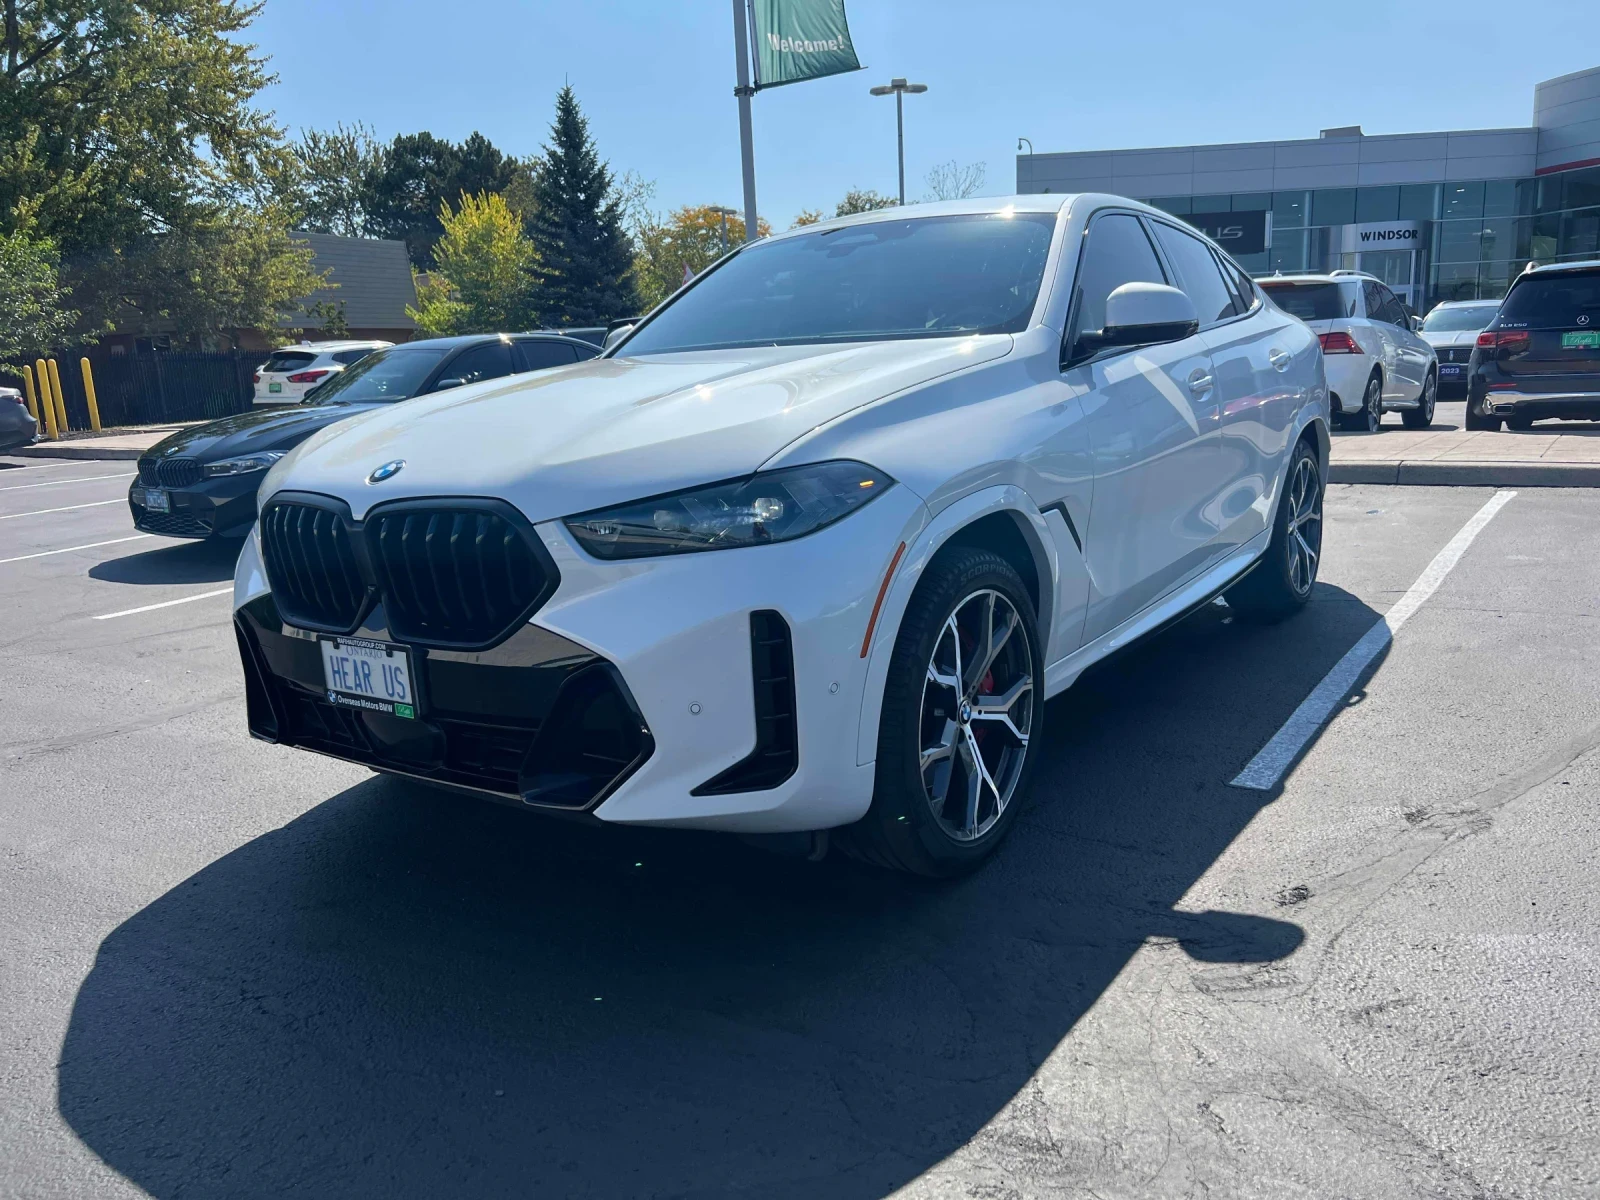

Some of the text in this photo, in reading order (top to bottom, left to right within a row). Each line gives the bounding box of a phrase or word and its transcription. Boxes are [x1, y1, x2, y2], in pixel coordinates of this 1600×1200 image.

[767, 33, 845, 53] Welcome!
[1360, 229, 1418, 242] WINDSOR
[960, 563, 1013, 585] SCORPION
[329, 655, 406, 700] HEAR US
[337, 694, 361, 707] Overseas
[360, 699, 379, 711] Motors
[379, 702, 393, 713] BMW
